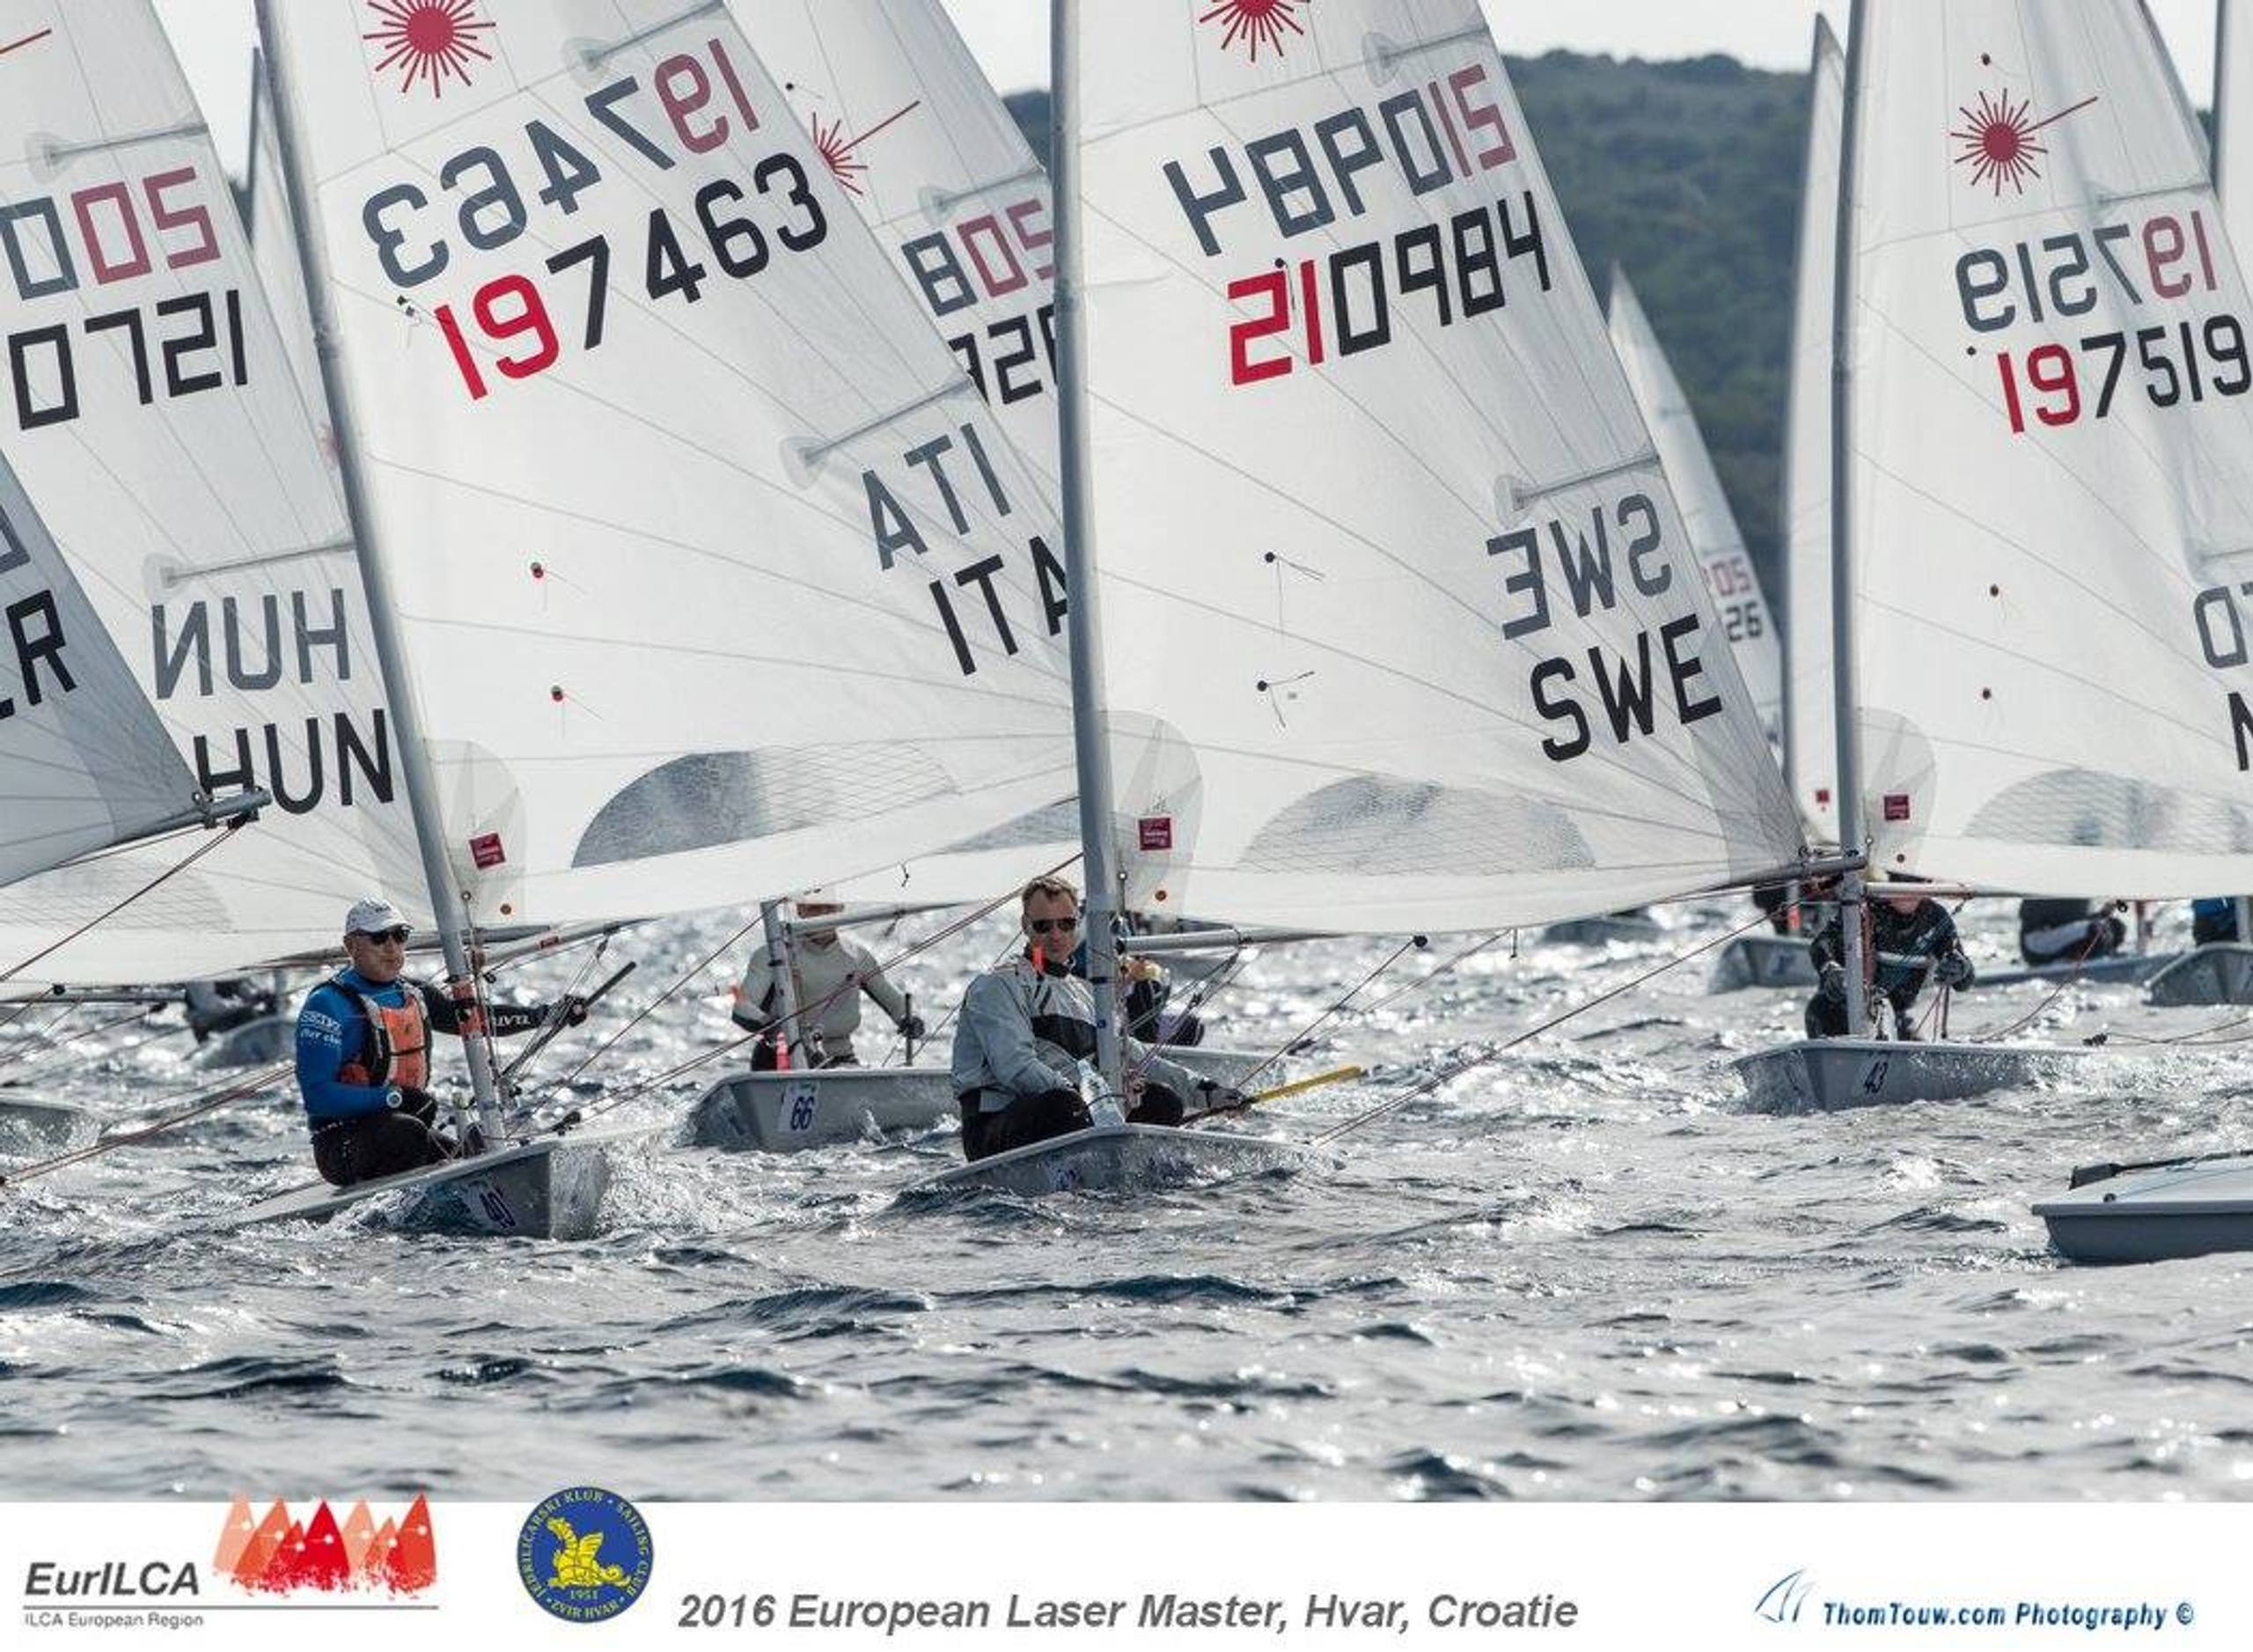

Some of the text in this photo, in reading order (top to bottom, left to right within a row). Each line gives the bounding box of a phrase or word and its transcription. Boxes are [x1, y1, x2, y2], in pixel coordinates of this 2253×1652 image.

[434, 152, 828, 400] 197463
[1227, 190, 1552, 385] 210984
[8, 289, 248, 430] 0721
[1997, 313, 2252, 434] 197519
[928, 535, 1069, 676] ITA
[1529, 613, 1723, 763] SWE
[193, 708, 394, 815] HUN
[789, 1095, 816, 1131] 66
